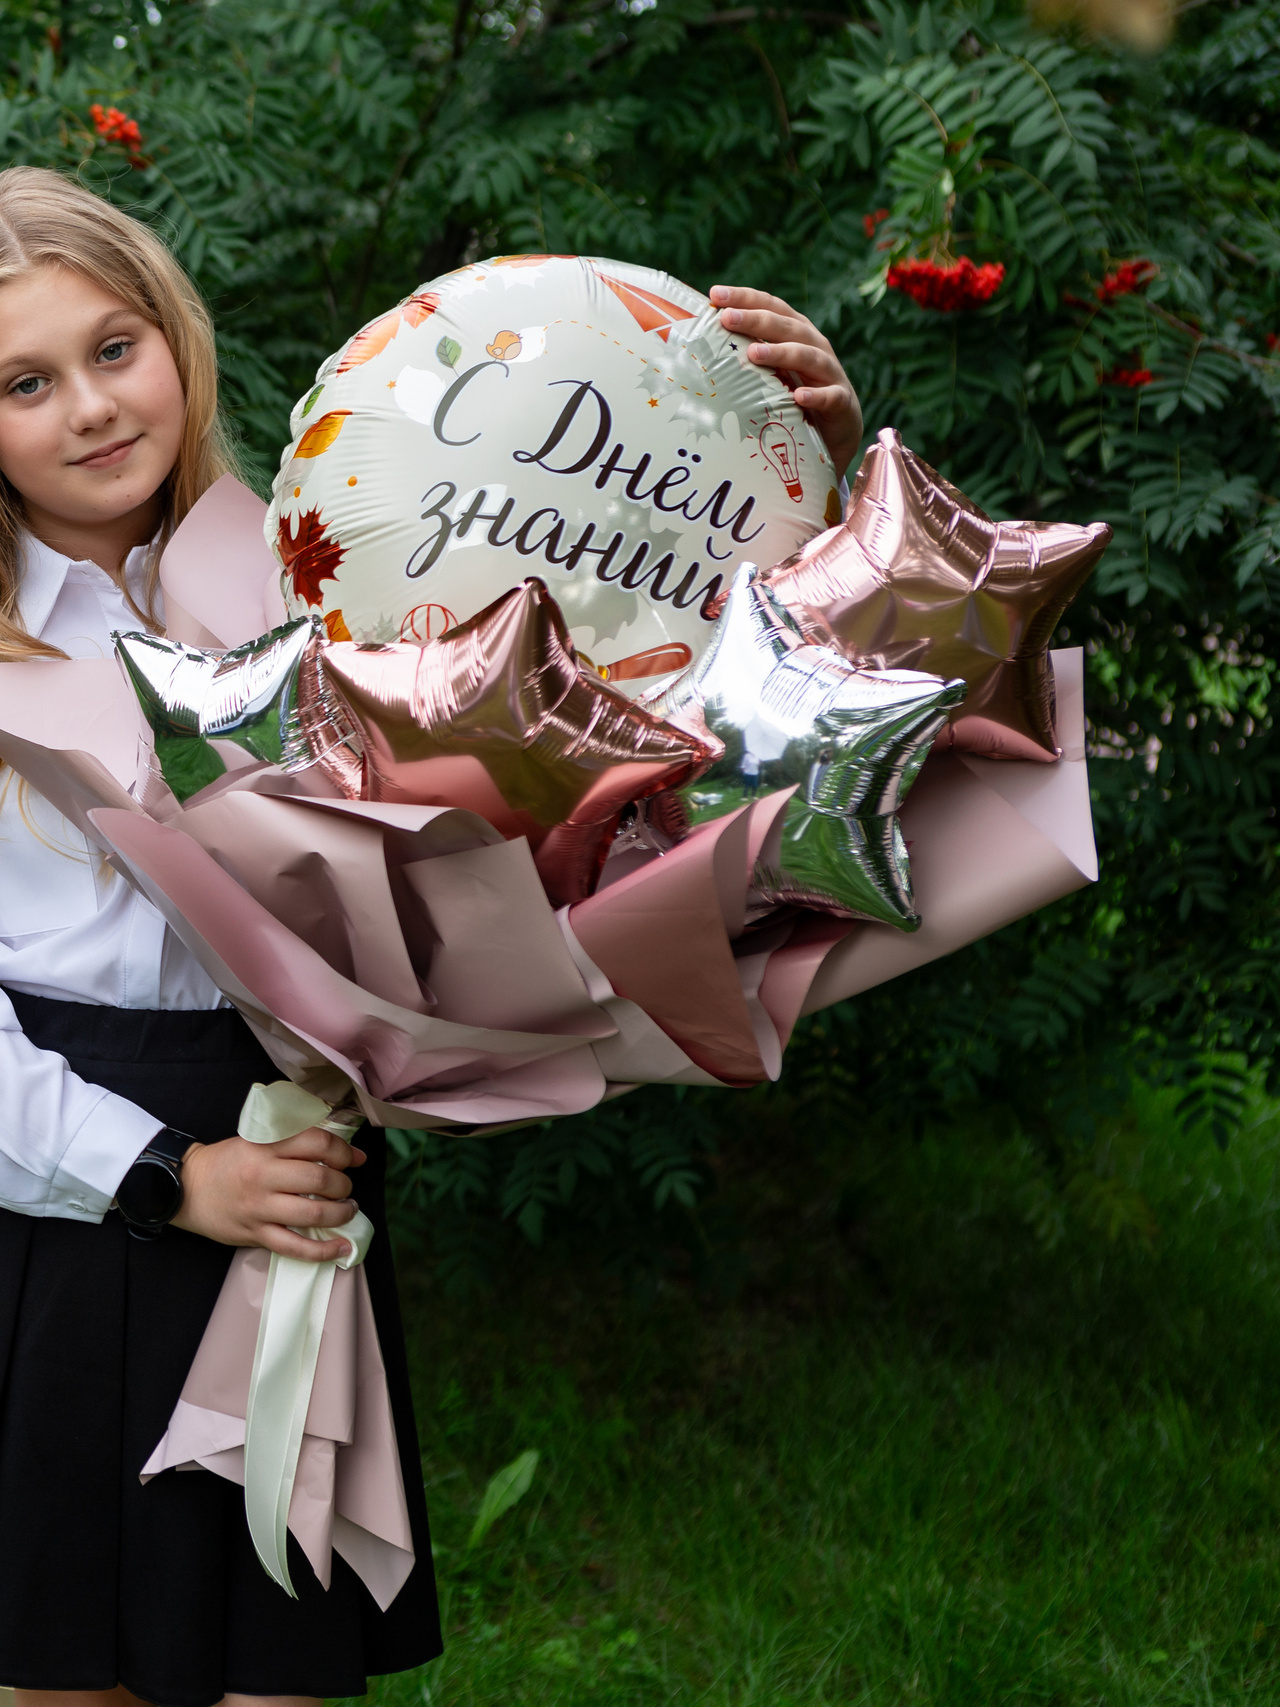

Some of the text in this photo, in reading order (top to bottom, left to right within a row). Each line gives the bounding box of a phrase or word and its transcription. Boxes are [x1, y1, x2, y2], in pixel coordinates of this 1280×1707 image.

[433, 359, 766, 543] С Днём
[405, 480, 733, 622] знаний
